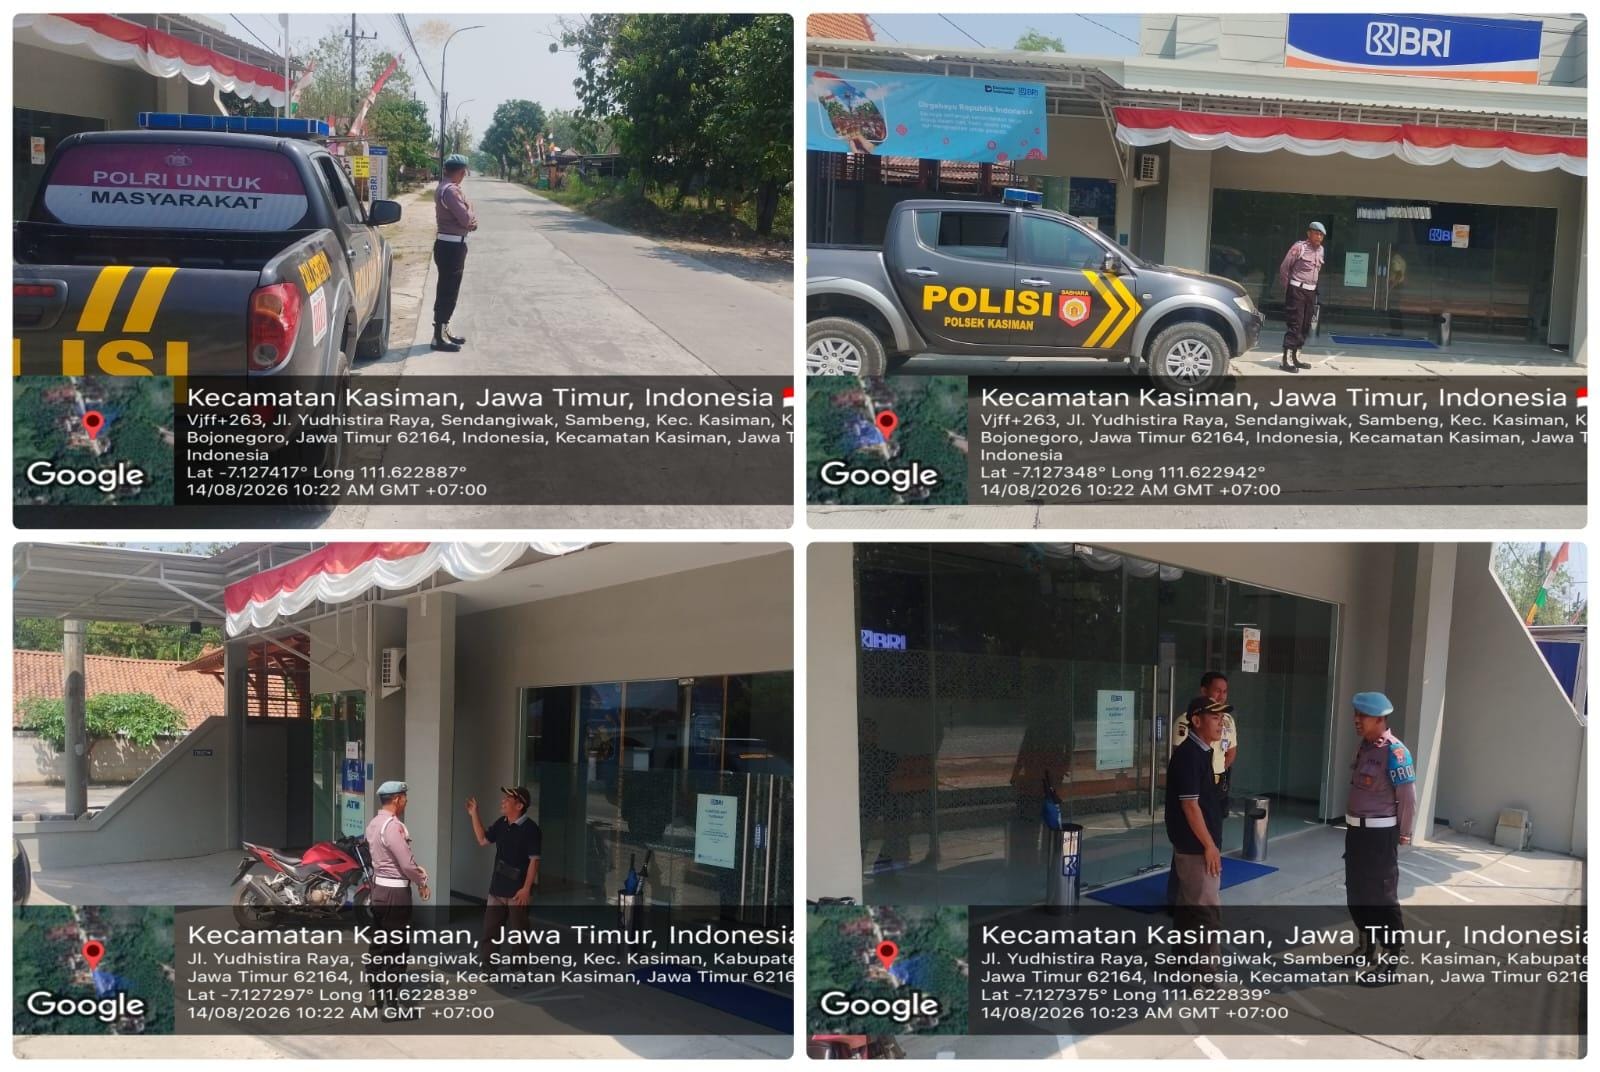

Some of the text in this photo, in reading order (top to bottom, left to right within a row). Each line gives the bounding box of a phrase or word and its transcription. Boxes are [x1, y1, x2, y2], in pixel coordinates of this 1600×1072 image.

[1399, 26, 1452, 58] BRI
[92, 170, 262, 190] POLRI UNTUK
[91, 190, 263, 209] MASYARAKAT
[922, 285, 1053, 317] POLISI
[943, 316, 1034, 331] POLSEK KASIMAN
[873, 632, 906, 650] BRI
